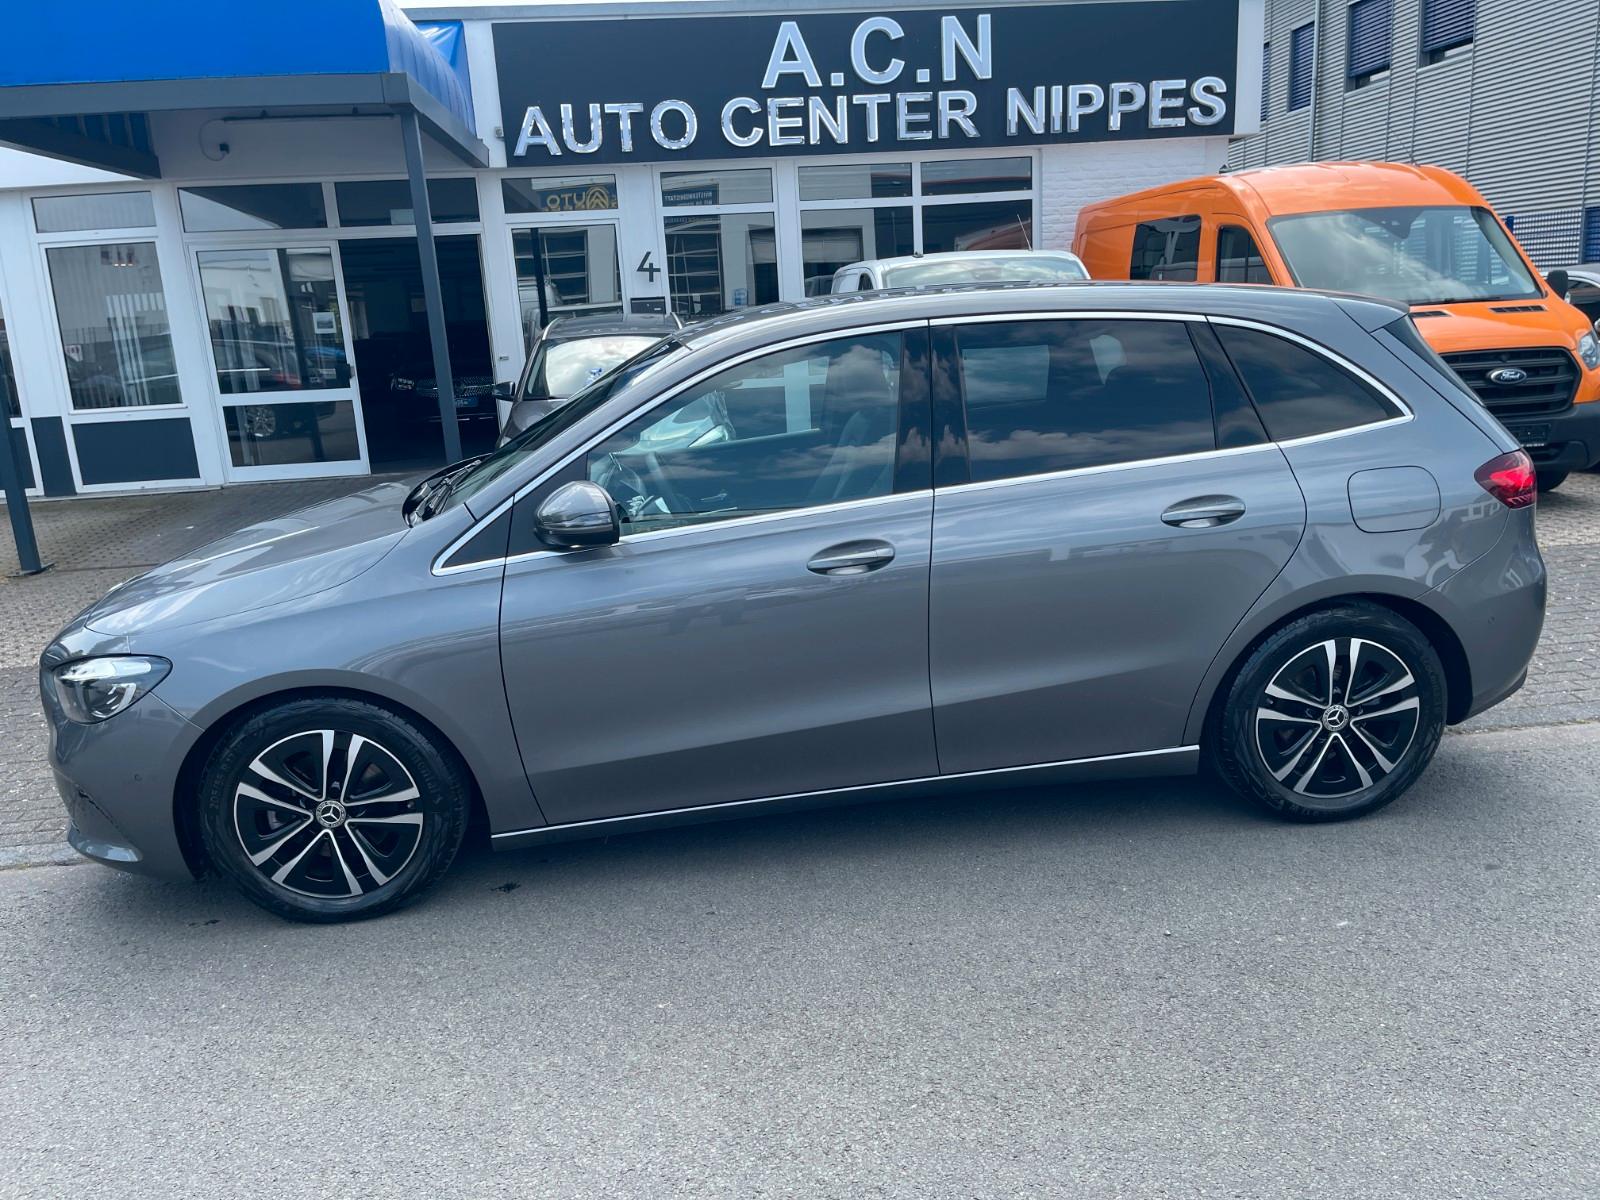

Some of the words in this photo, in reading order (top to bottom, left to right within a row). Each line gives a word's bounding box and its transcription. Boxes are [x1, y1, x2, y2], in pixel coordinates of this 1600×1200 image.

[761, 13, 993, 89] A.C.N
[513, 99, 698, 157] AUTO
[720, 90, 980, 148] CENTER
[1006, 76, 1229, 136] NIPPES
[636, 251, 661, 282] 4
